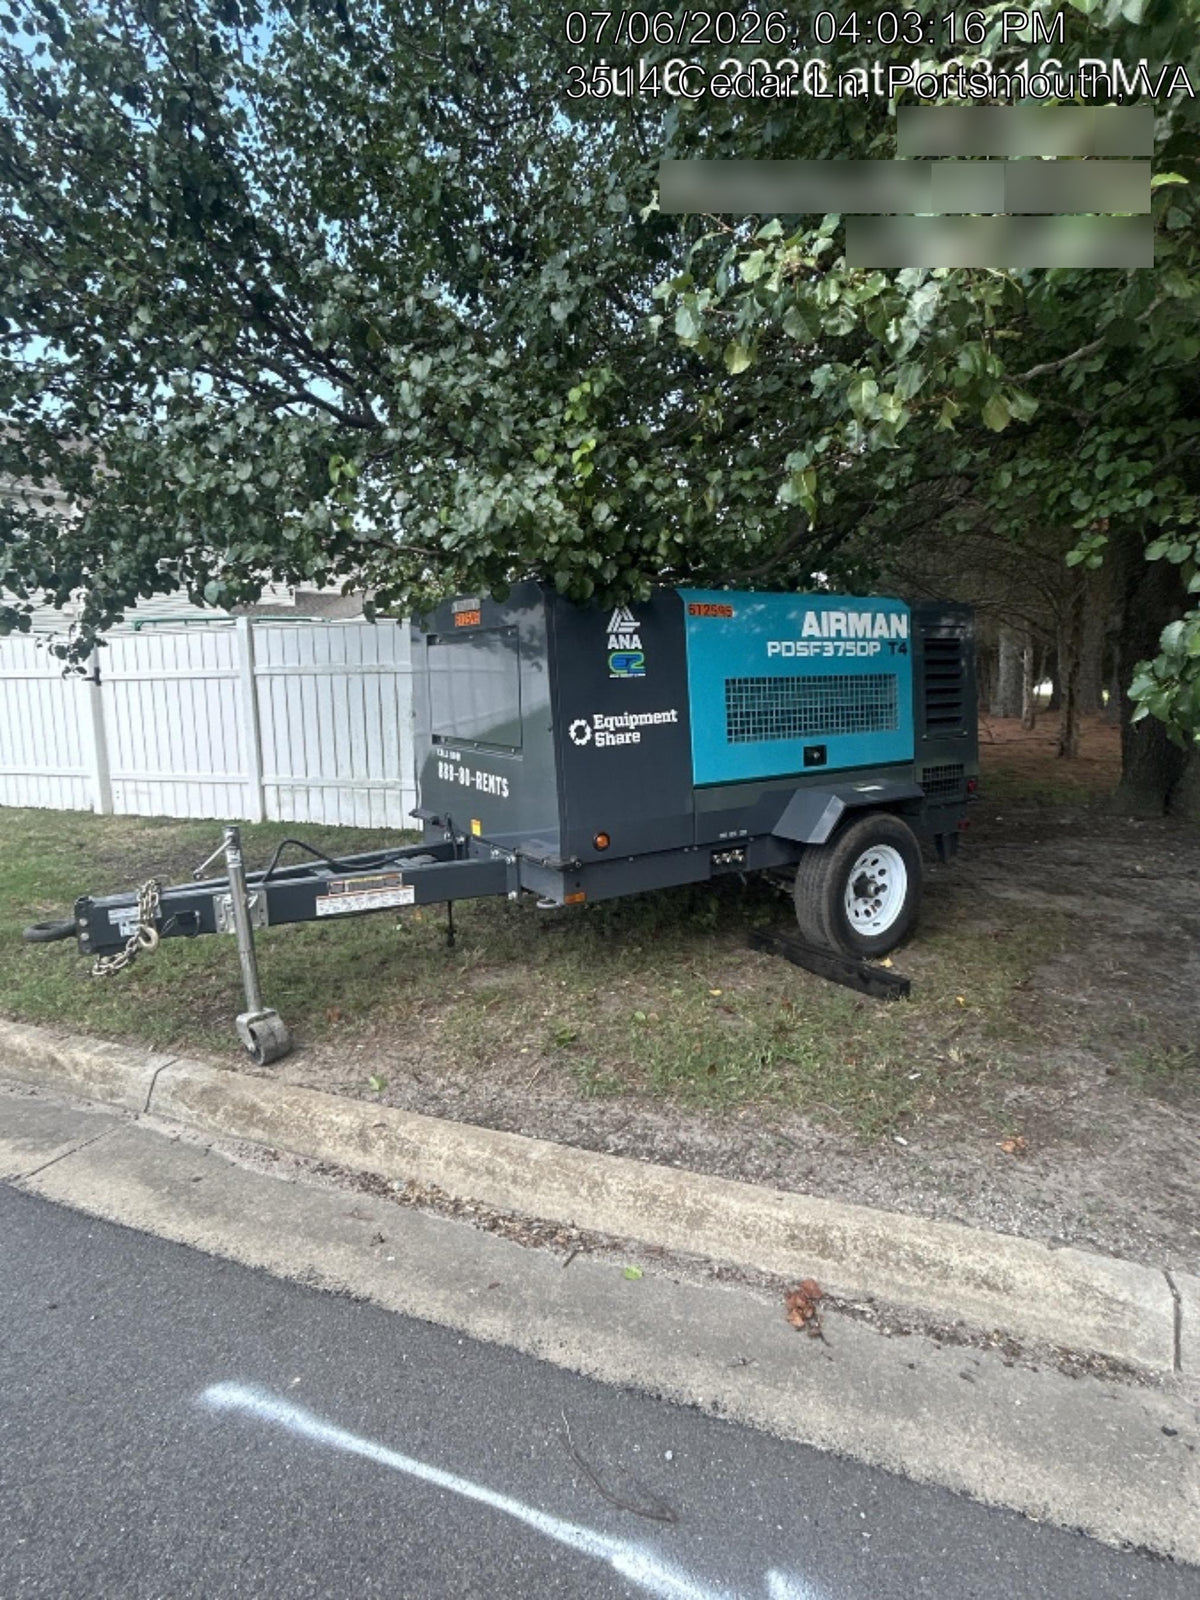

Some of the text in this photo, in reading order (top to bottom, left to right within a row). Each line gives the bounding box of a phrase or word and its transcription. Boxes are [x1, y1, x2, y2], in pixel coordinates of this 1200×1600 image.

[802, 611, 908, 638] AIRMAN
[607, 634, 643, 650] ANA
[888, 642, 907, 655] T4
[593, 709, 678, 731] Equipment
[595, 732, 641, 747] Share
